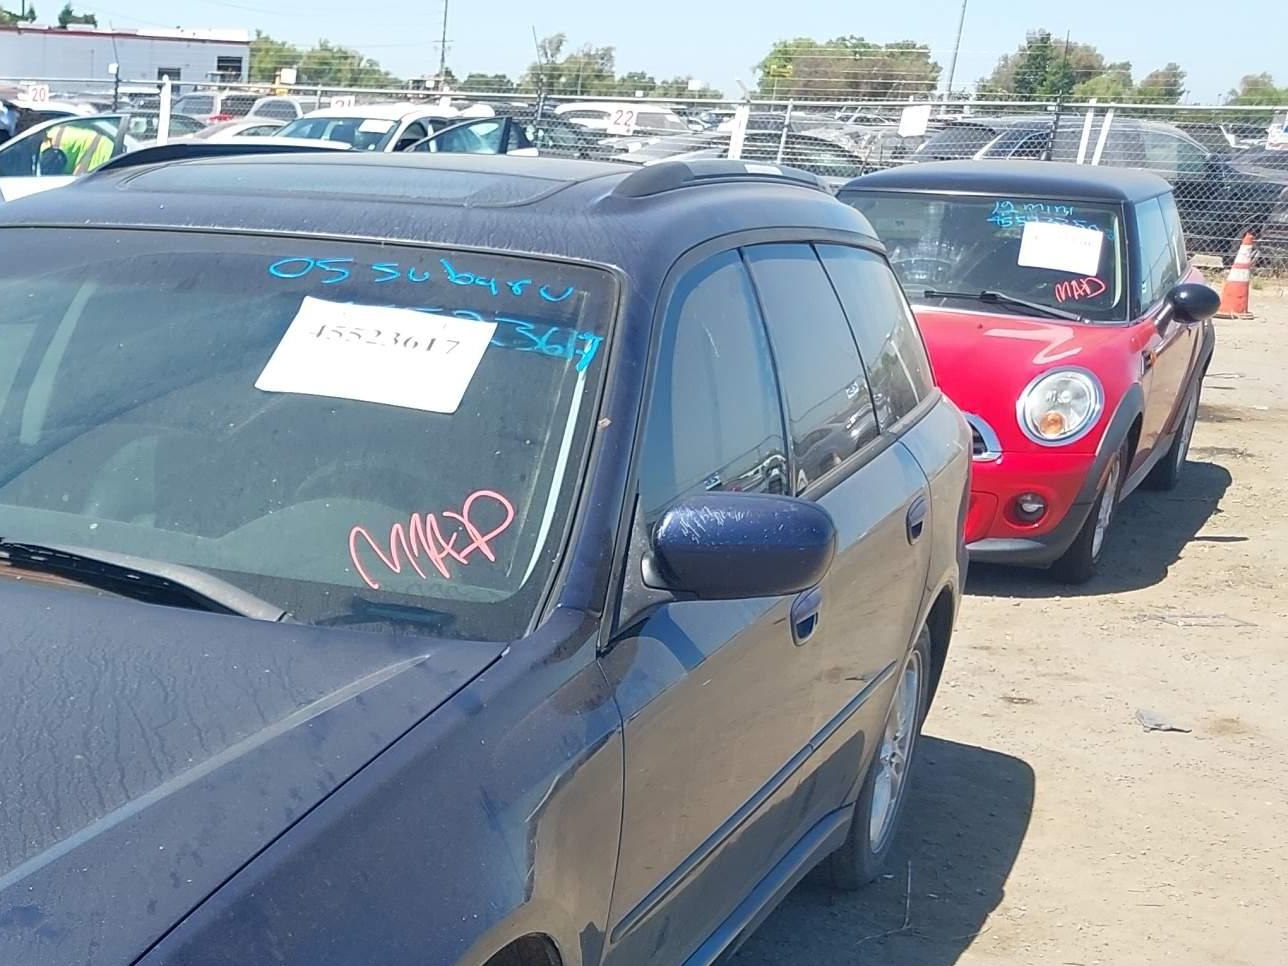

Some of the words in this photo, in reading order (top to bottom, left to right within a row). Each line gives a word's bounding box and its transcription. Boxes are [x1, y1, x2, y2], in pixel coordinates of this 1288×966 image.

[32, 87, 46, 102] 20
[613, 109, 634, 127] 22
[268, 256, 353, 285] 05
